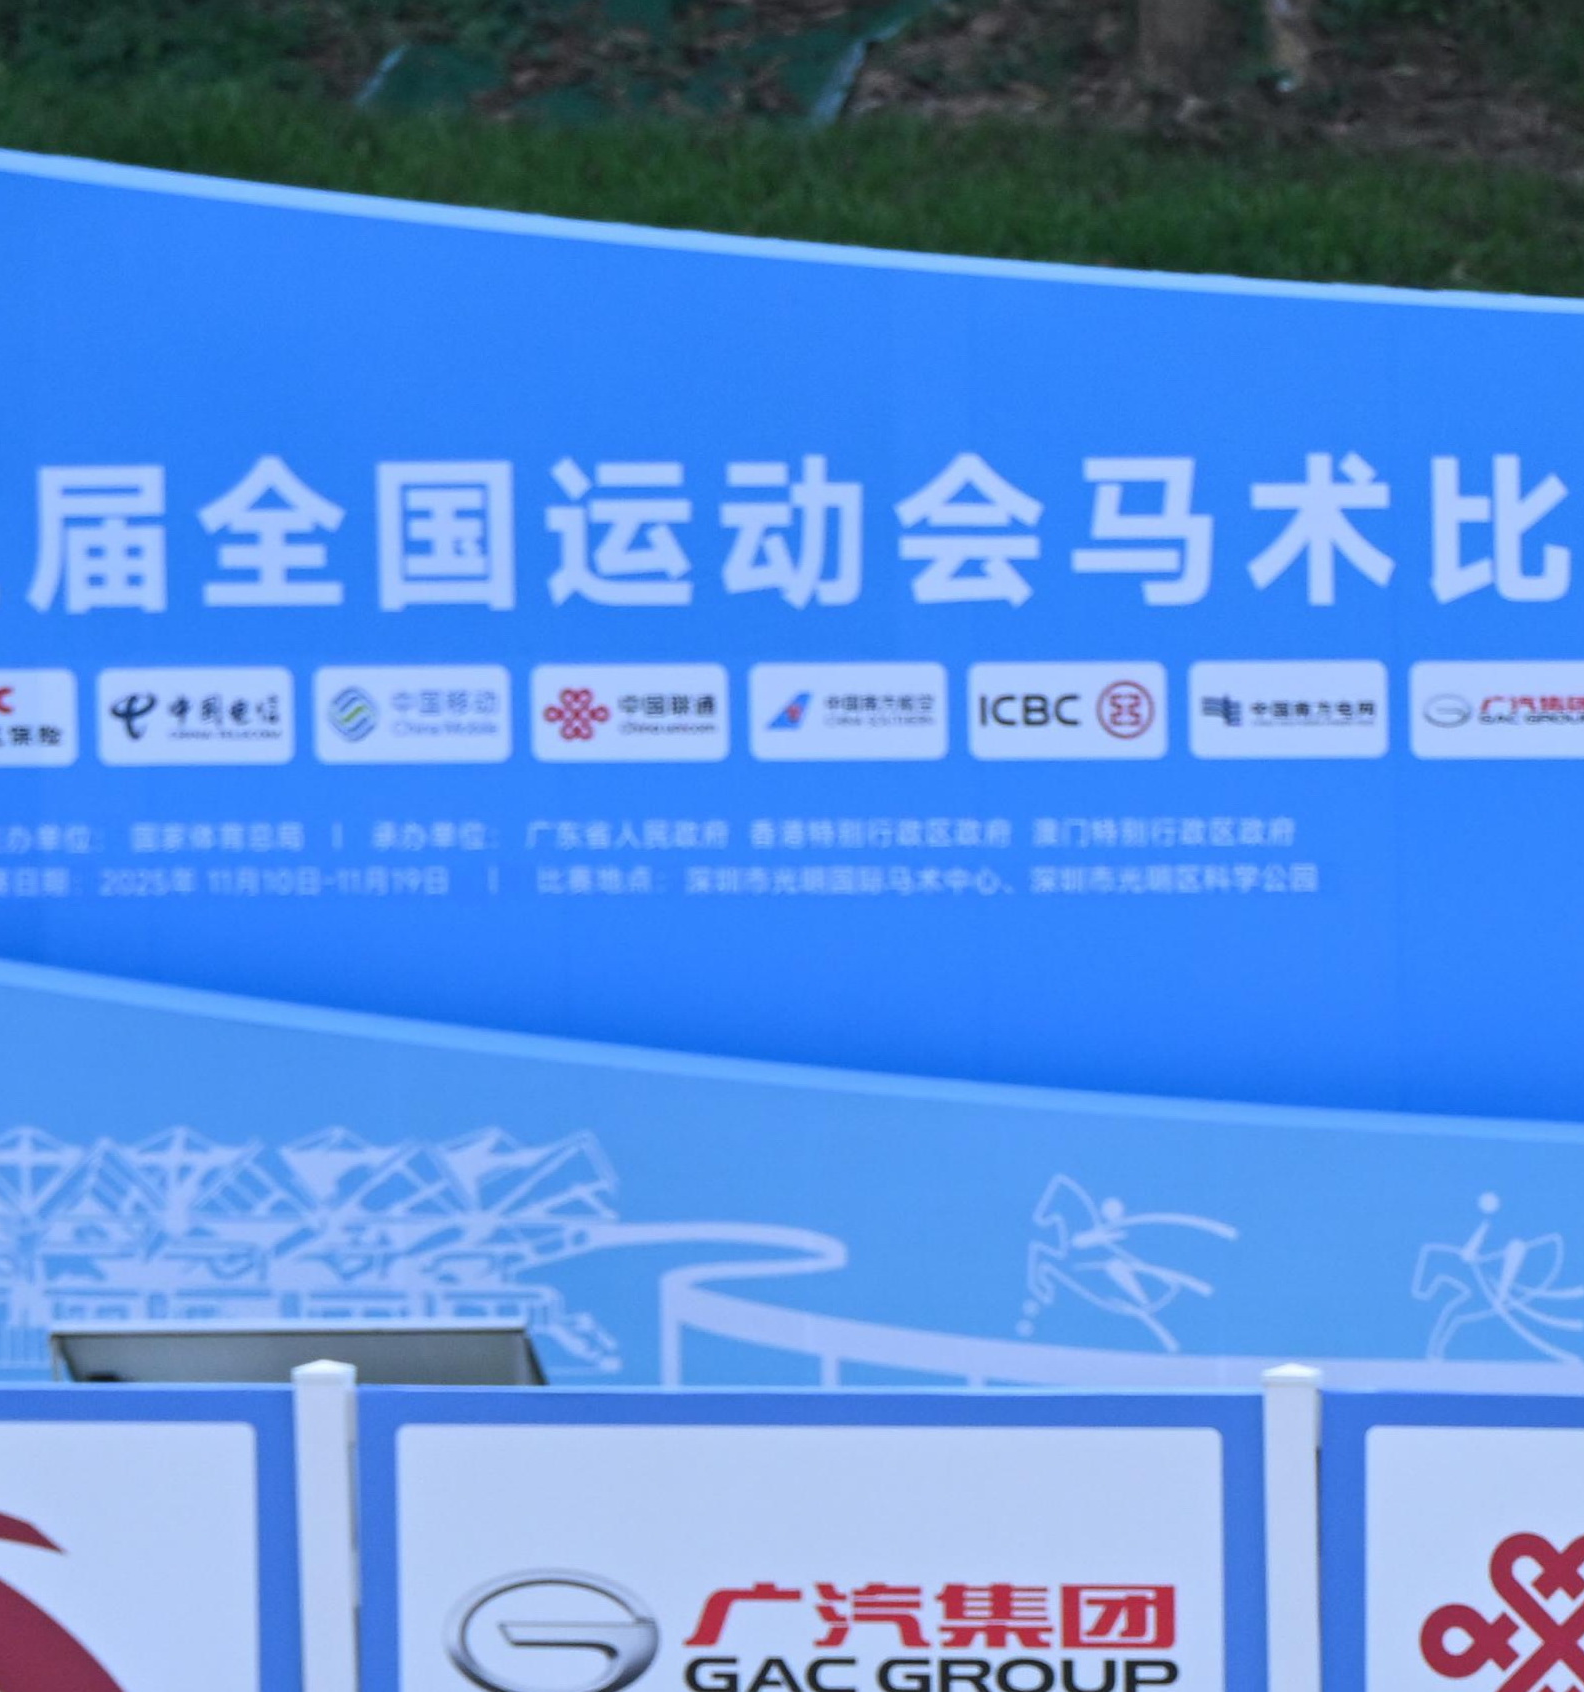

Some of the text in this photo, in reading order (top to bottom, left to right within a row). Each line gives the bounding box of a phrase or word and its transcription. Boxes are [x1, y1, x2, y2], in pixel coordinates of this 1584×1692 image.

[619, 693, 717, 717] 中国联通
[979, 693, 1081, 728] ICBC
[682, 1581, 1177, 1650] 广汽集团
